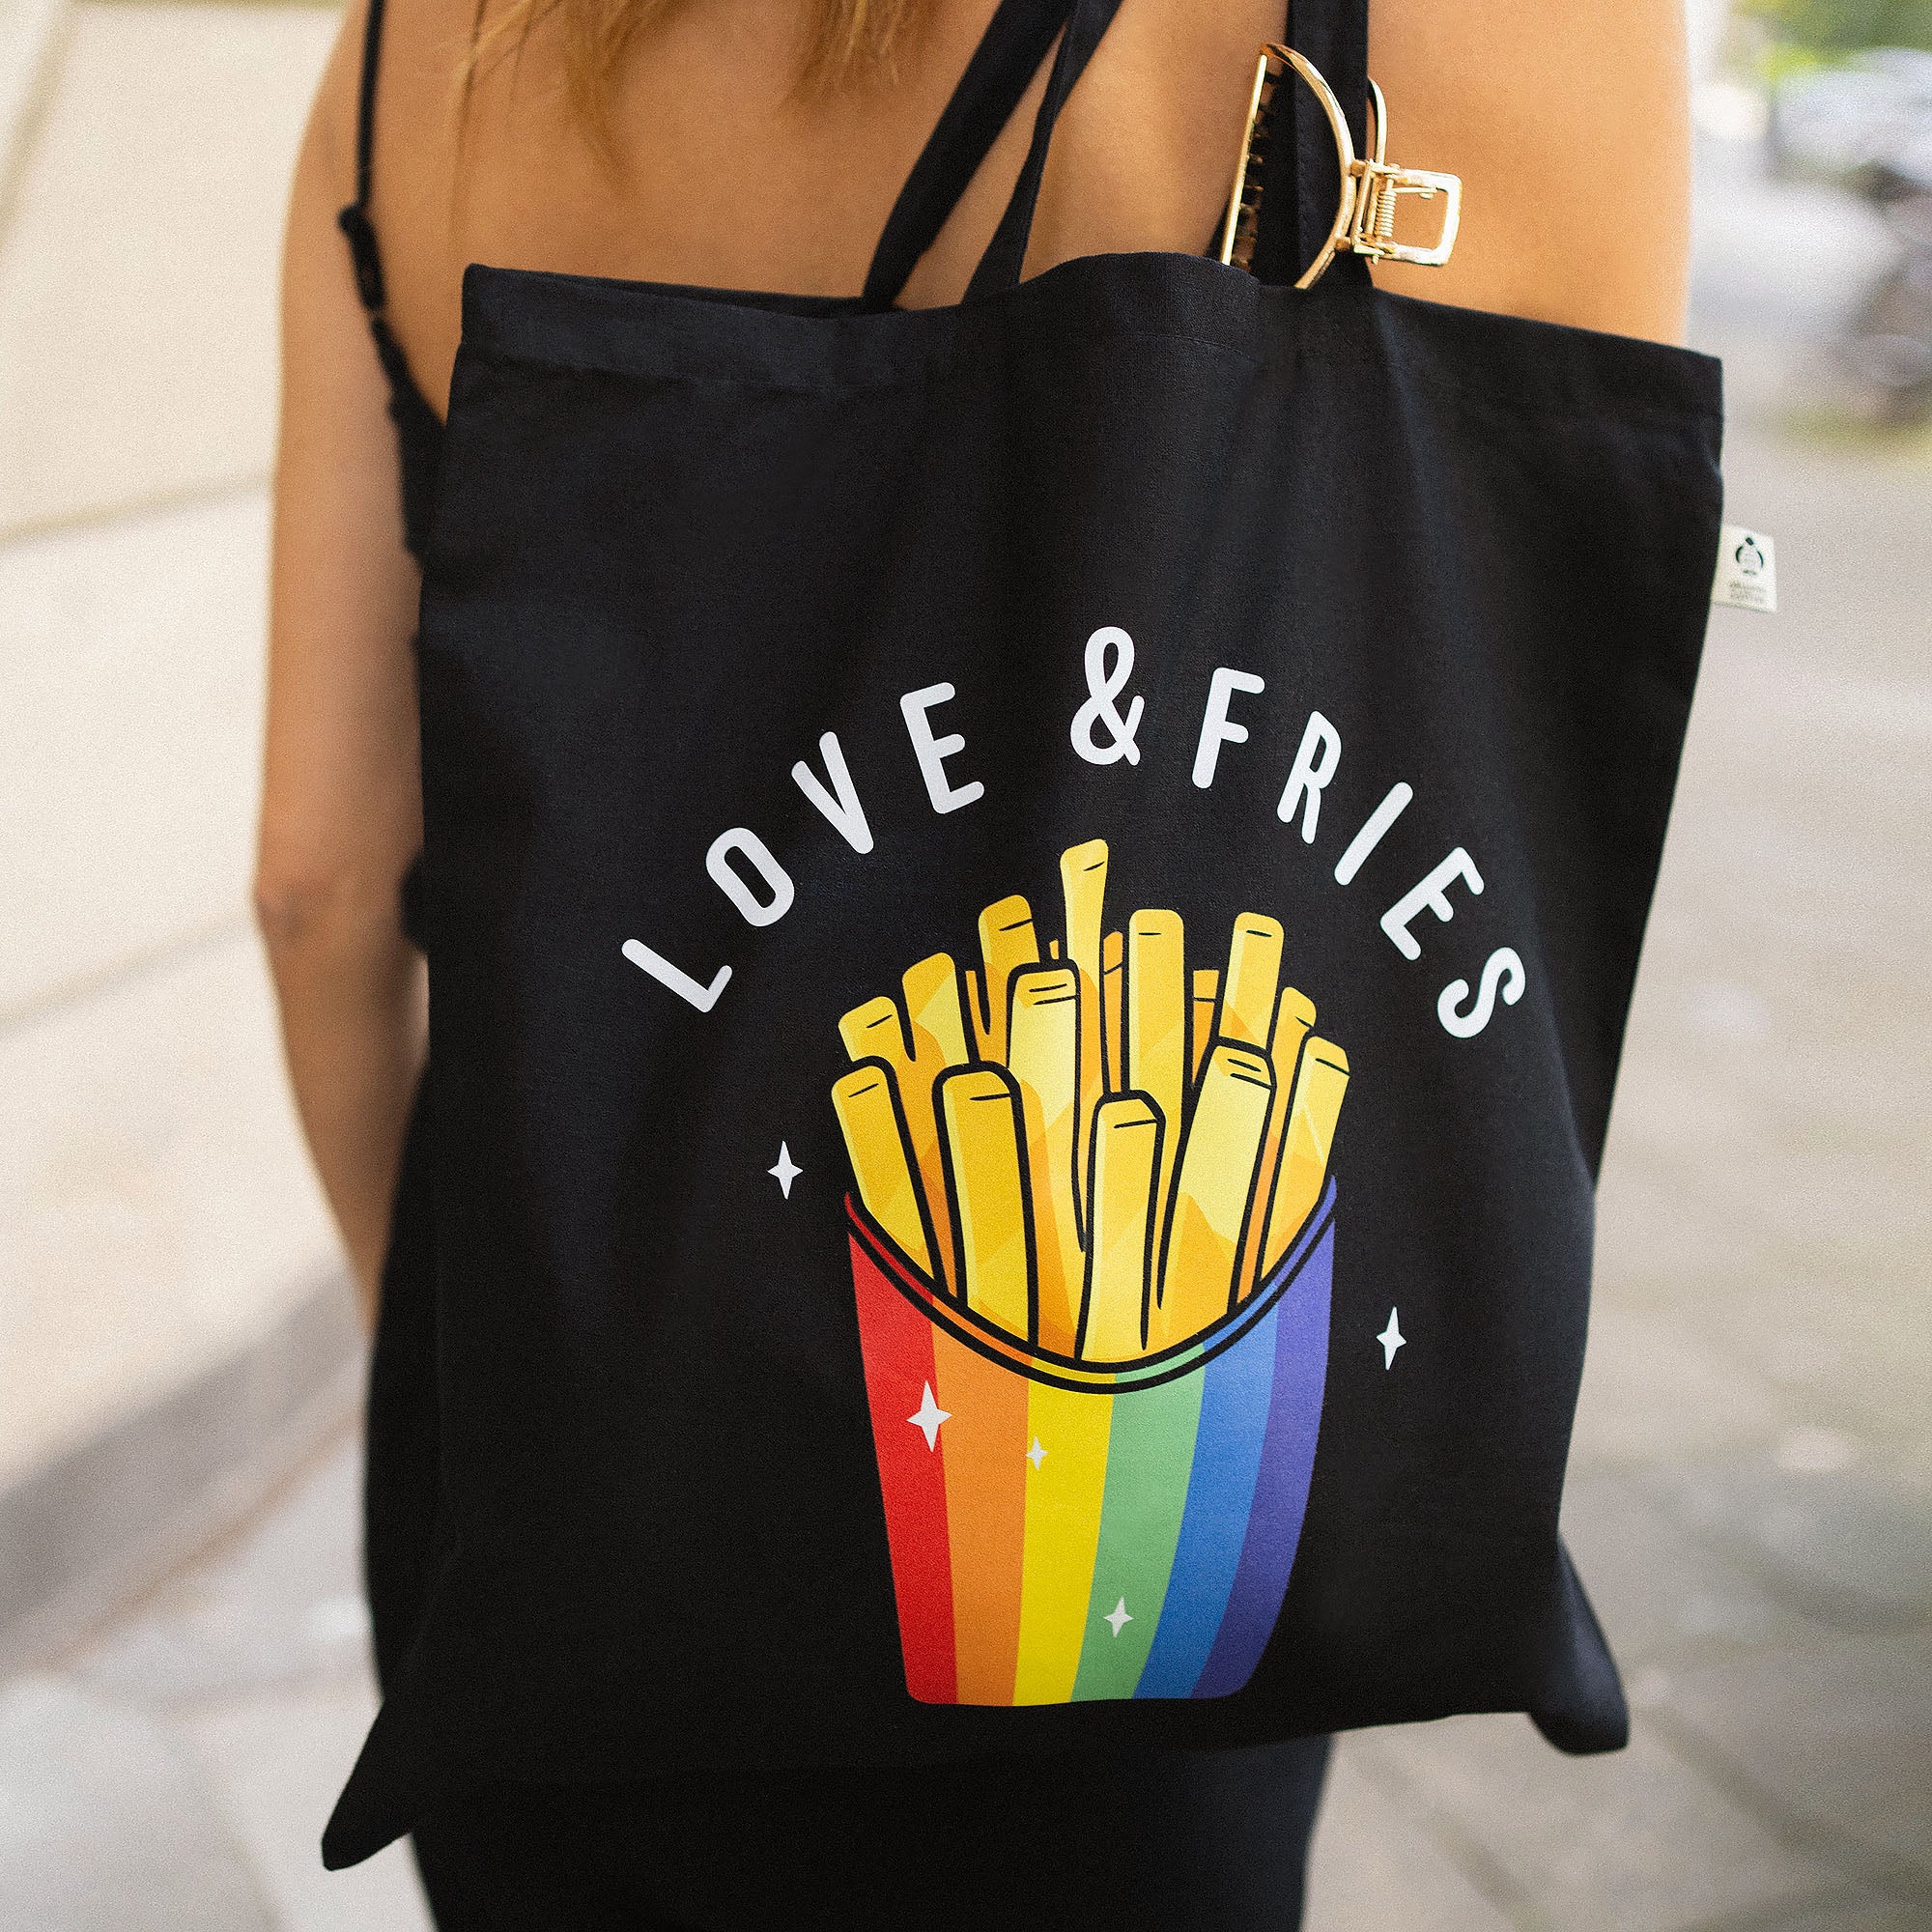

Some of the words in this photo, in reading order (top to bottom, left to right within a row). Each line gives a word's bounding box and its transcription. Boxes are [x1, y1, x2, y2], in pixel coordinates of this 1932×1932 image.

[621, 681, 985, 1013] LOVE
[1069, 626, 1146, 766] &
[1191, 667, 1526, 1038] FRIES
